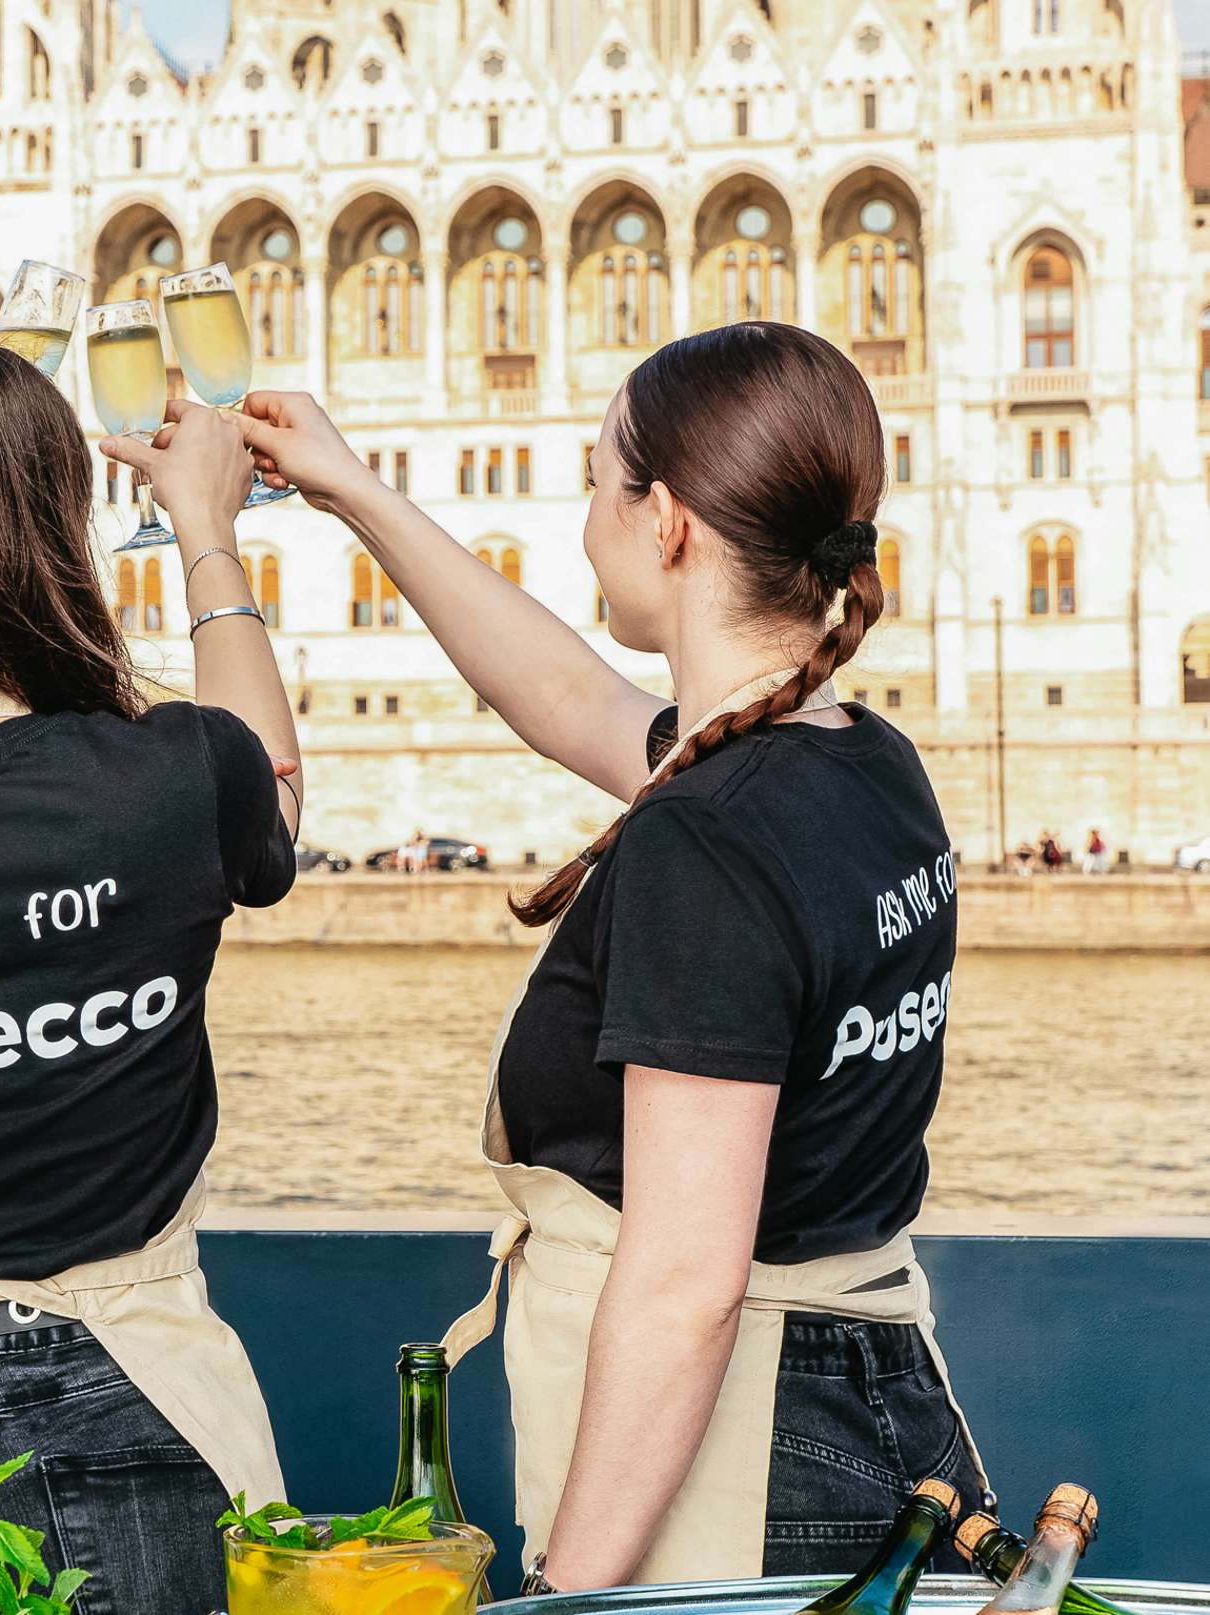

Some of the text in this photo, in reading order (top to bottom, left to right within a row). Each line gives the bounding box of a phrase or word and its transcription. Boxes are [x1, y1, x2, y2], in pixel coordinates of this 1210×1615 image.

[23, 878, 117, 940] for
[876, 851, 956, 949] Ask me fo
